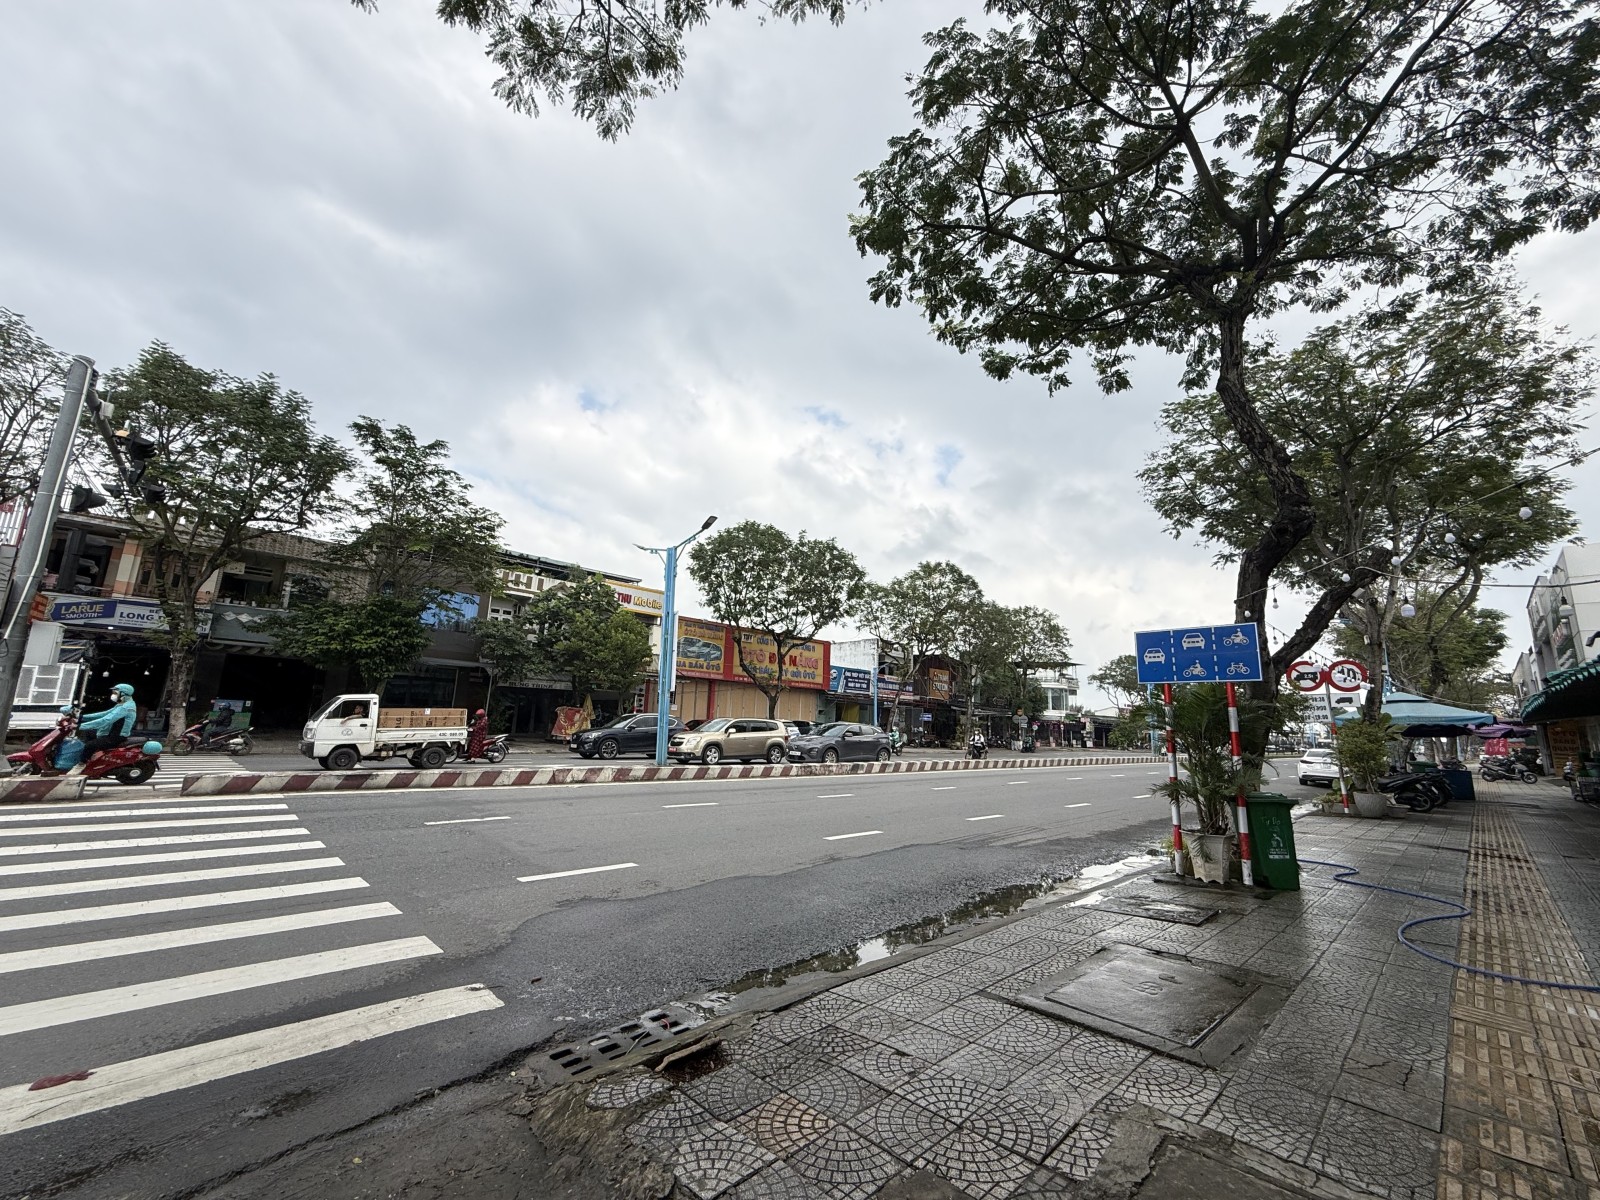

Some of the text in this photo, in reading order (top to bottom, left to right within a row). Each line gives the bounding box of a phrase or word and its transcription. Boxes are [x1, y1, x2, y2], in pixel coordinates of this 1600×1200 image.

[617, 592, 662, 610] THU Mobile
[61, 604, 105, 614] LARUE
[119, 611, 154, 621] LONG
[688, 660, 704, 669] BÁN
[705, 662, 721, 671] ÔTÔ
